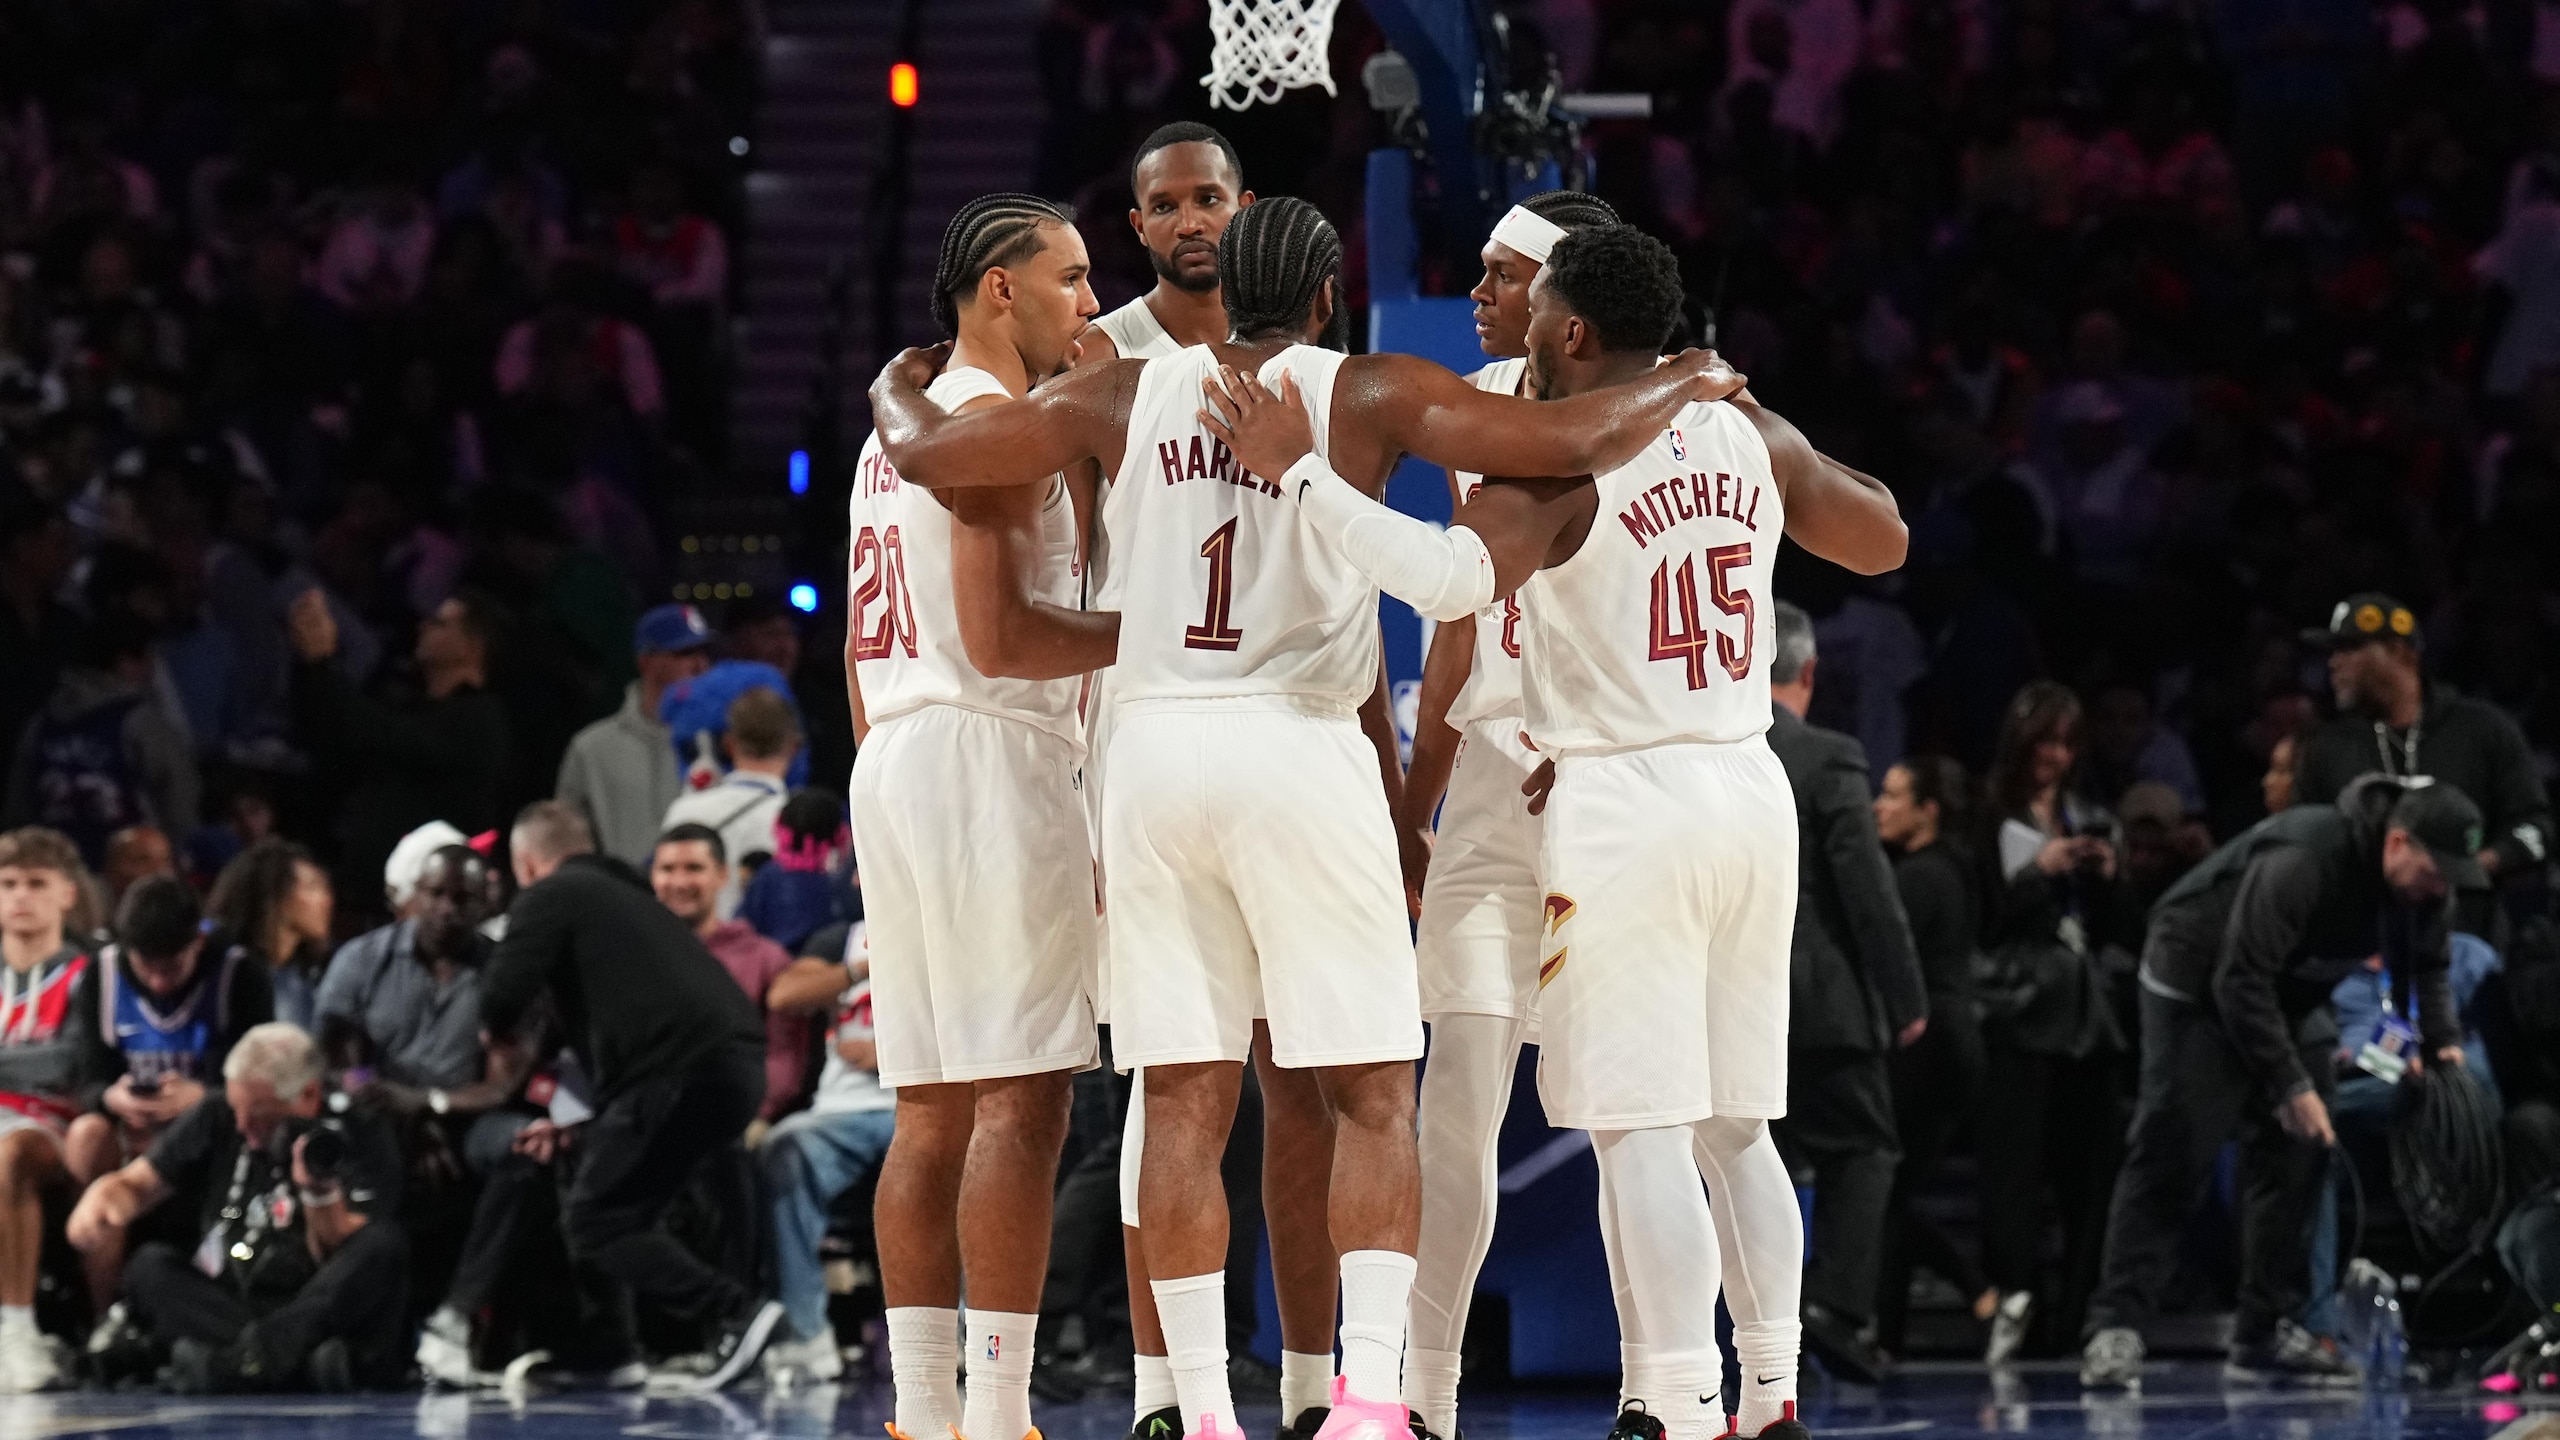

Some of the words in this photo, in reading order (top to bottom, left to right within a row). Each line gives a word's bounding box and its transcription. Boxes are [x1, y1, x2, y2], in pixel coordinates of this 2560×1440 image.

[1158, 435, 1282, 500] HAR
[1618, 472, 1760, 550] MITCHELL
[853, 524, 919, 662] 20
[1184, 515, 1243, 651] 1
[1648, 541, 1755, 692] 45
